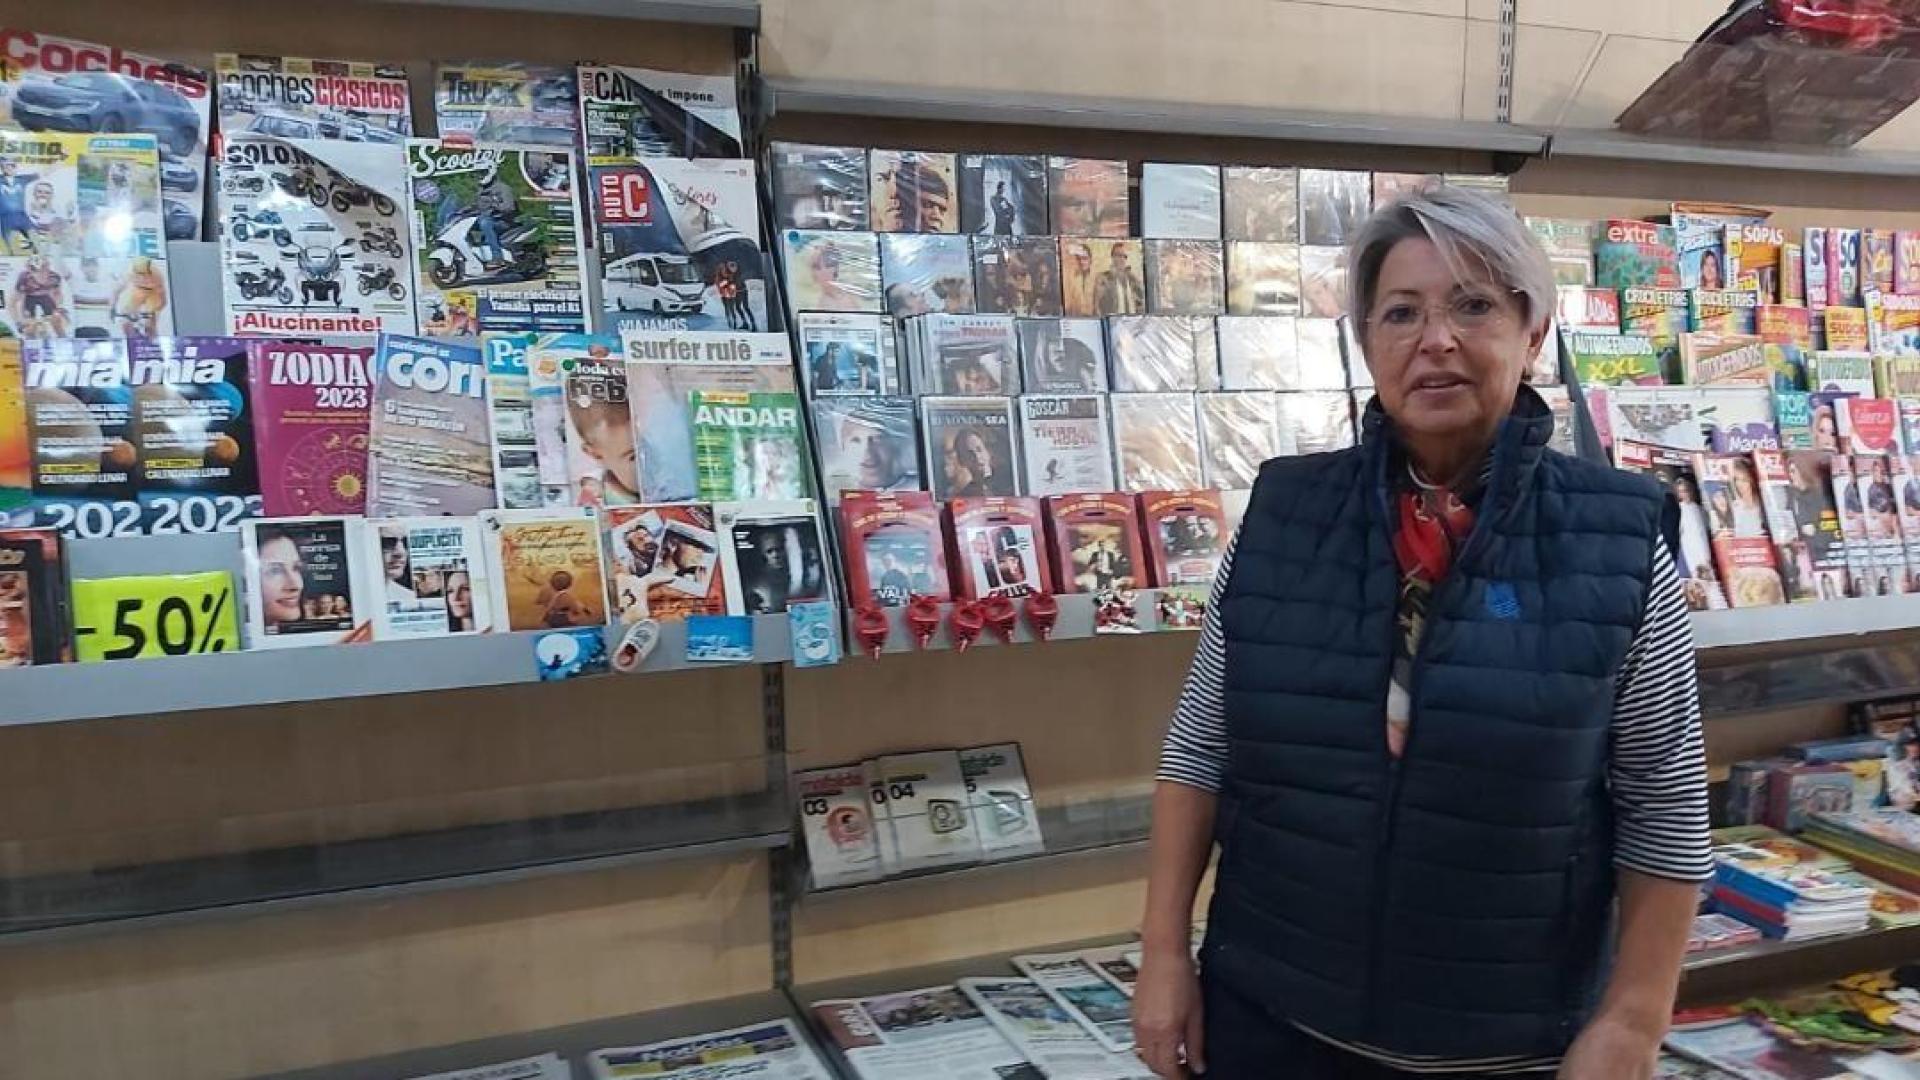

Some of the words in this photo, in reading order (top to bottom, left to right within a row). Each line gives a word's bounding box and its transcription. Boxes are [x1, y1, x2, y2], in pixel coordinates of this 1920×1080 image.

[601, 174, 624, 218] AUTO
[1607, 225, 1659, 245] extra
[1743, 226, 1784, 245] SOPAS
[234, 313, 383, 333] ¡Alucinante!
[630, 339, 701, 361] surfer
[315, 387, 368, 409] 2023
[695, 406, 797, 428] ANDAR
[76, 587, 229, 660] -50%
[889, 782, 915, 800] 04
[803, 798, 829, 816] 03
